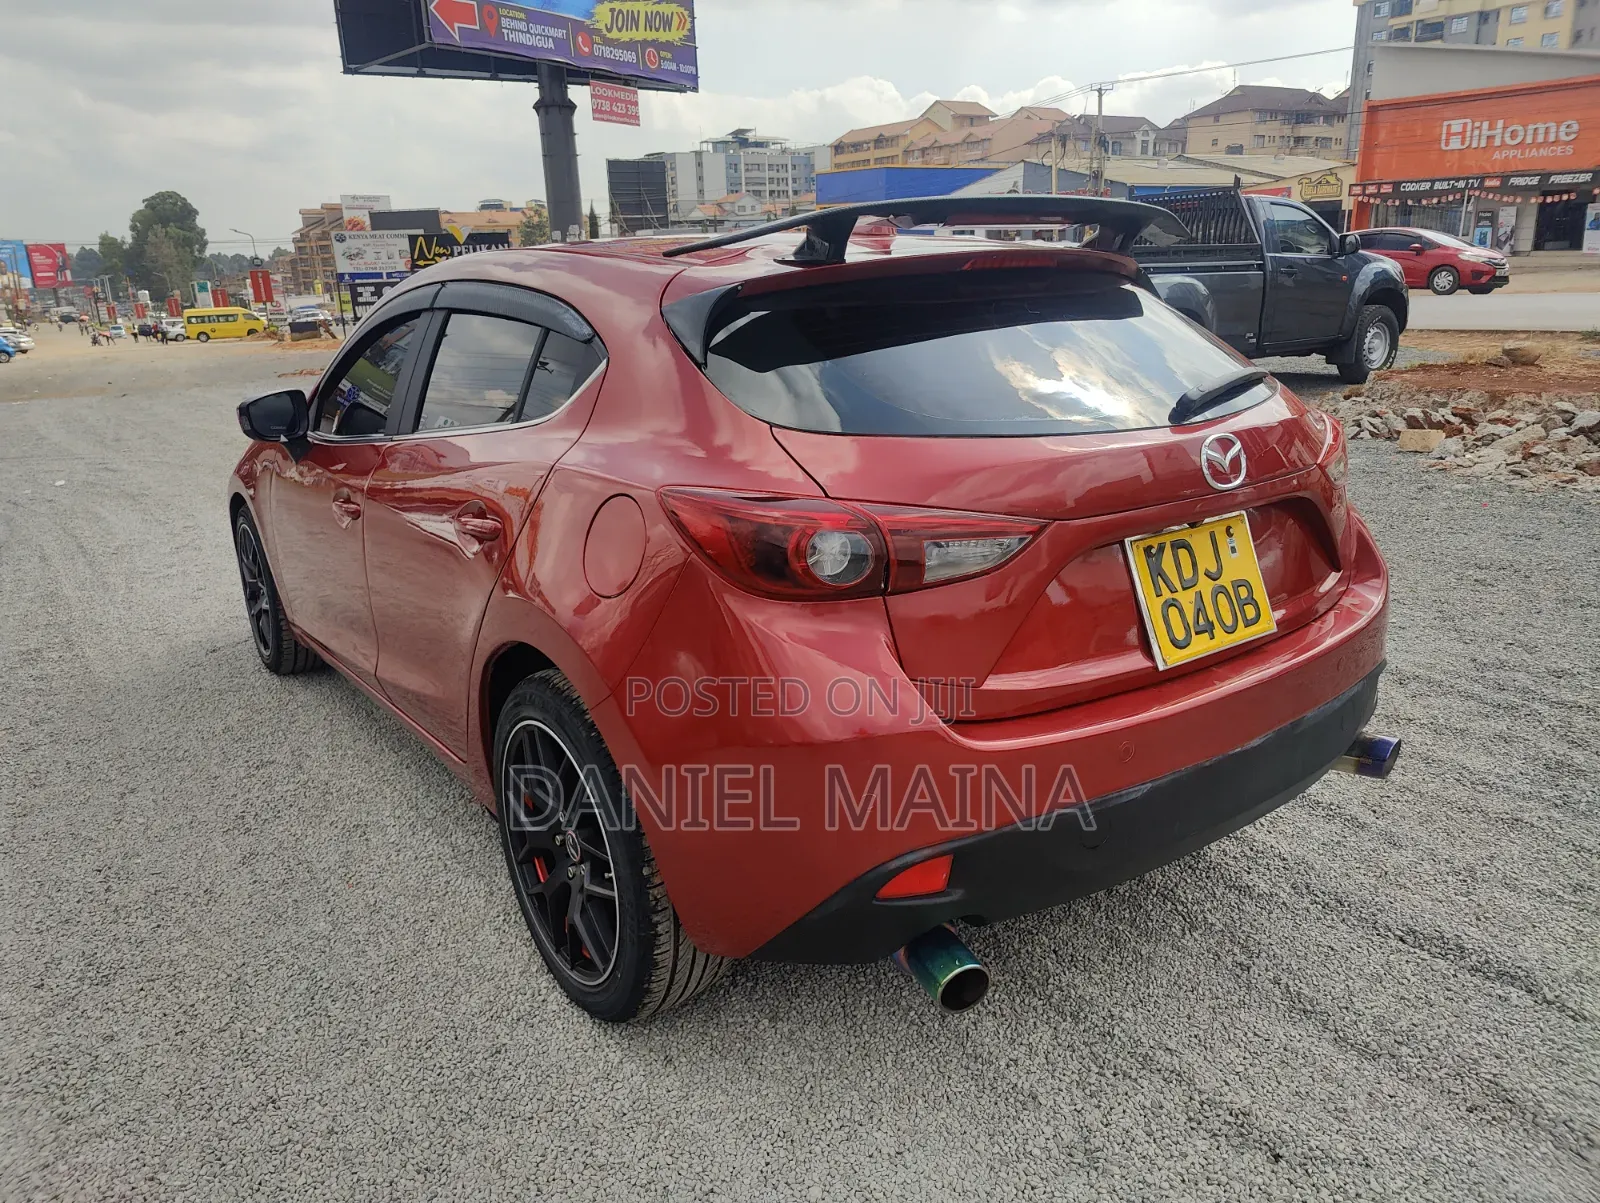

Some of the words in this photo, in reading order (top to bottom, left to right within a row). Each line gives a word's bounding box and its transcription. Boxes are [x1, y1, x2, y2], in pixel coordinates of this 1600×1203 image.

[501, 17, 528, 32] BEHIND
[529, 23, 567, 39] QUICKMART
[605, 8, 640, 33] JOIN
[644, 10, 674, 33] NOW
[502, 29, 555, 50] THINDIGUA
[593, 44, 637, 63] 0718295069
[592, 99, 611, 112] 0738
[612, 102, 627, 114] 423
[1492, 145, 1574, 160] APPLIANCES
[1400, 182, 1431, 192] COOKER
[1433, 180, 1467, 190] BUILT-IN
[1468, 179, 1481, 188] TV
[1508, 176, 1542, 186] FRIDGE
[1548, 173, 1593, 184] FREEZER
[413, 236, 451, 259] New
[1143, 531, 1224, 598] KDJ
[1161, 579, 1262, 650] 040B
